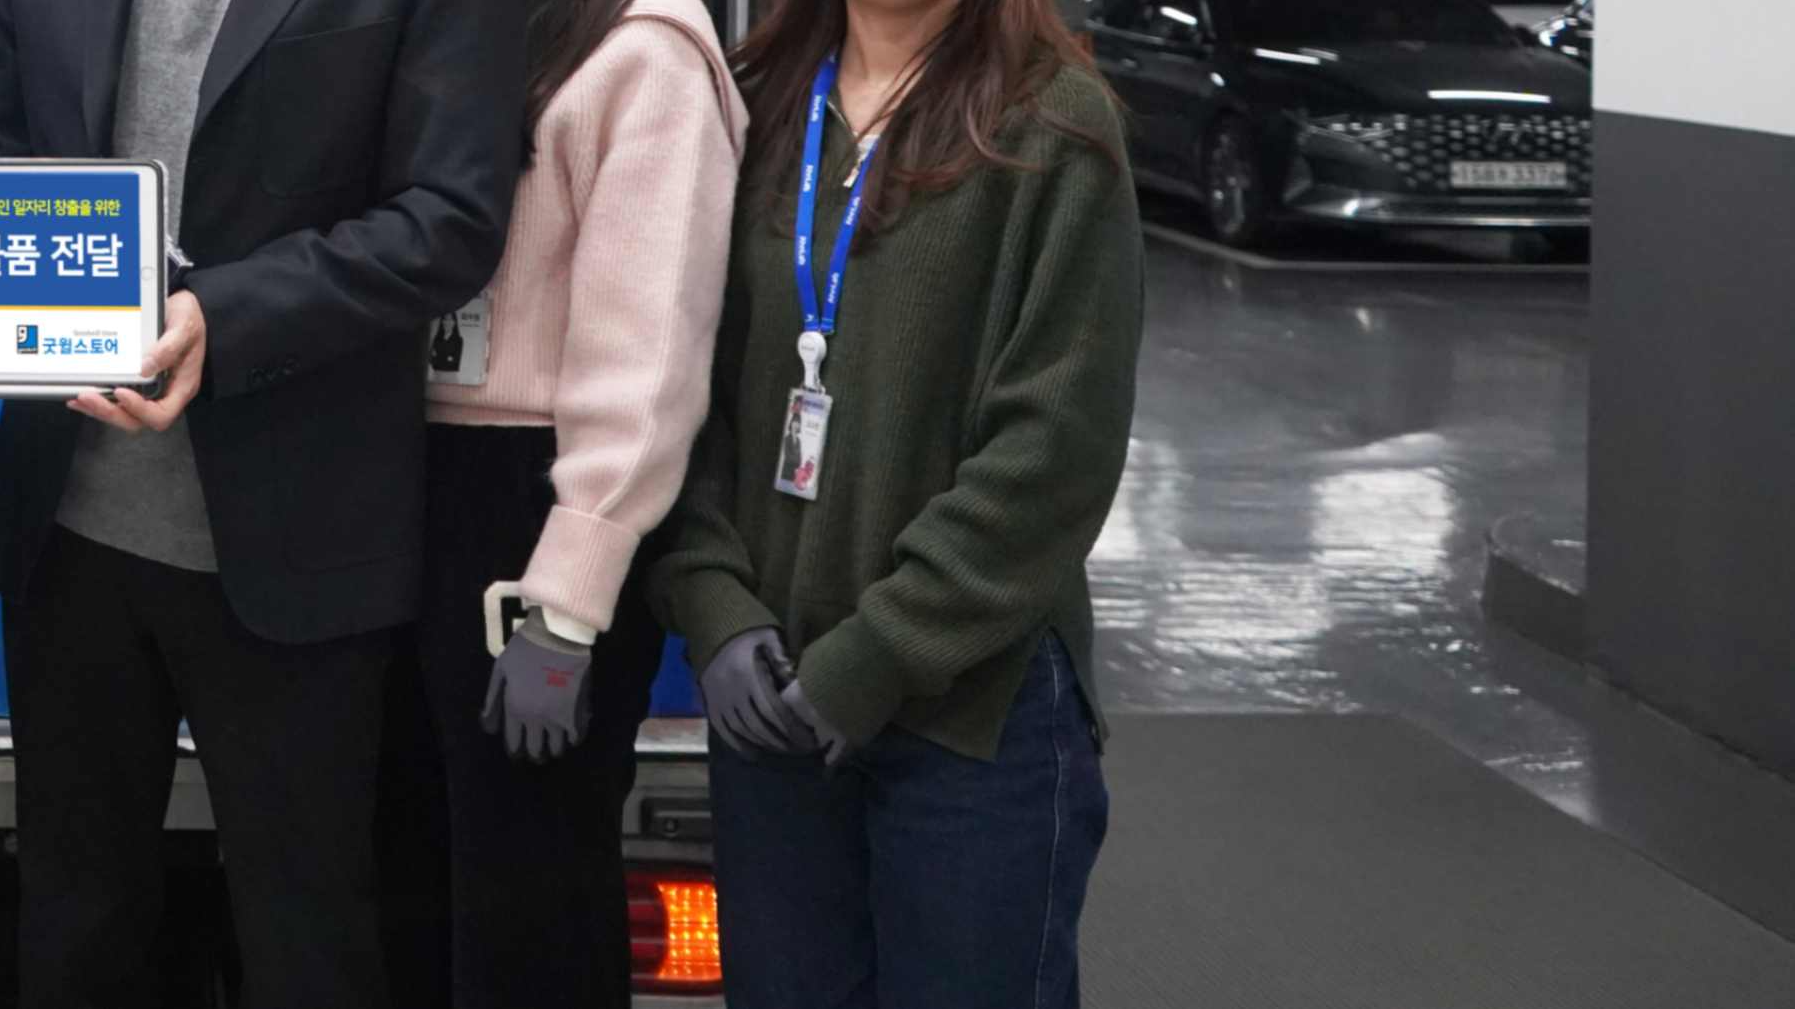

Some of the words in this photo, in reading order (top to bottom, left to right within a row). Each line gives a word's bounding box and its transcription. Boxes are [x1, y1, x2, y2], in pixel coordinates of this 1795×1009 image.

[13, 198, 51, 216] 일자리
[54, 198, 92, 216] 창출을
[94, 198, 121, 216] 위한
[51, 233, 124, 277] 전달
[42, 337, 118, 355] 굿윌스토어
